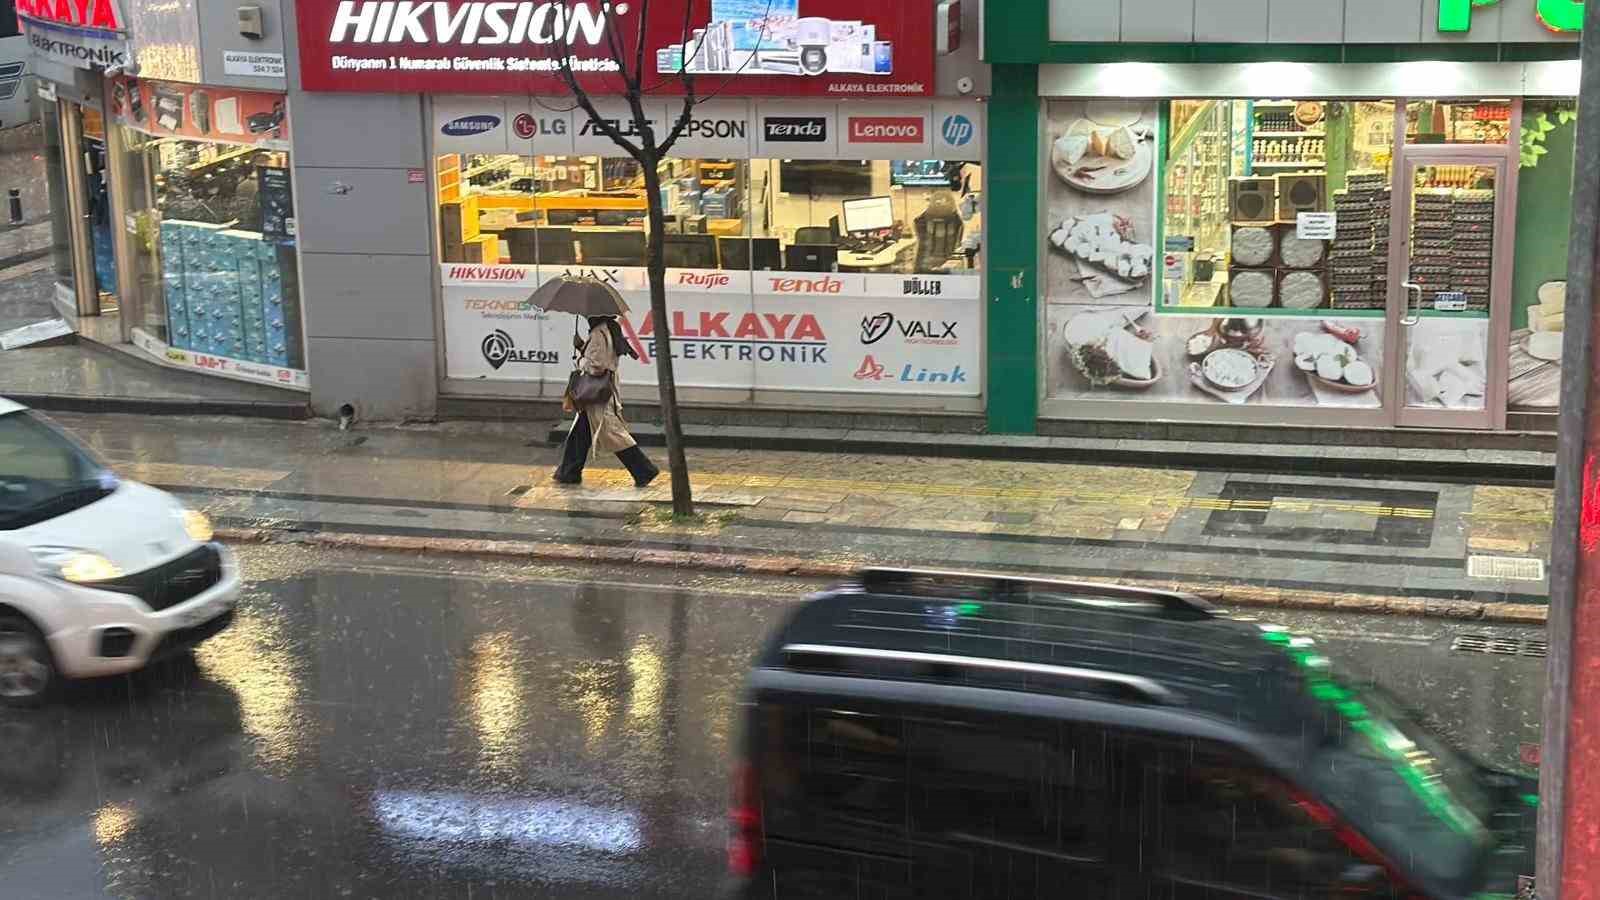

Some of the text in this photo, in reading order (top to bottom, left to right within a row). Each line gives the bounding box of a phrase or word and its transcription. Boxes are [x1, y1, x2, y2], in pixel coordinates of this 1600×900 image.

[329, 1, 609, 45] HIKVISION
[389, 56, 397, 69] 1
[453, 57, 504, 70] Güvenlik
[828, 83, 864, 92] ALKAYA
[448, 120, 495, 130] SAMSUNG
[540, 119, 567, 135] LG
[767, 121, 822, 136] Tenda
[855, 122, 917, 136] Lenovo
[946, 115, 970, 145] hp
[450, 267, 526, 280] HIKVISION
[679, 272, 729, 289] Ruijie
[769, 276, 842, 293] Tenda
[897, 320, 958, 338] VALX
[508, 350, 559, 361] ALFON
